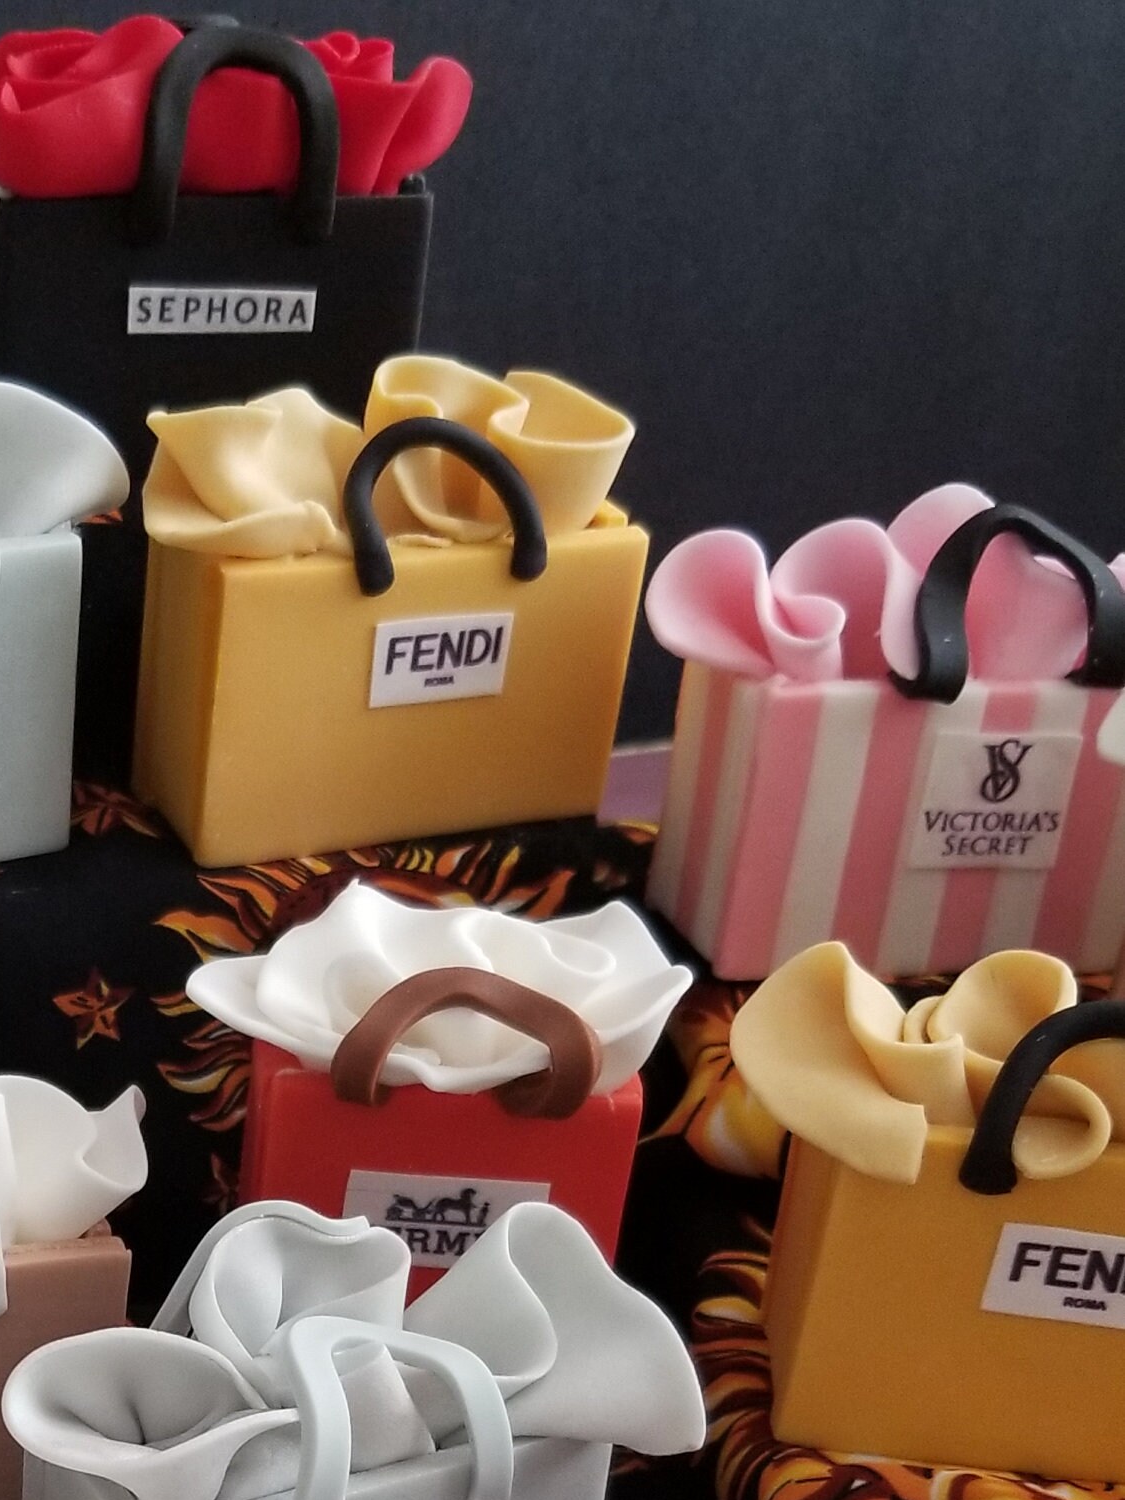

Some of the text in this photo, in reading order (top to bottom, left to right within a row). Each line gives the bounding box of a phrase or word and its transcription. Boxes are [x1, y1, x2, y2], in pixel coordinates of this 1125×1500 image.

[136, 296, 307, 325] SEPHORA
[384, 625, 504, 675] FENDI
[923, 810, 1060, 833] VICTORIA'S
[941, 834, 1034, 857] SECRET
[1007, 1241, 1125, 1296] FEN
